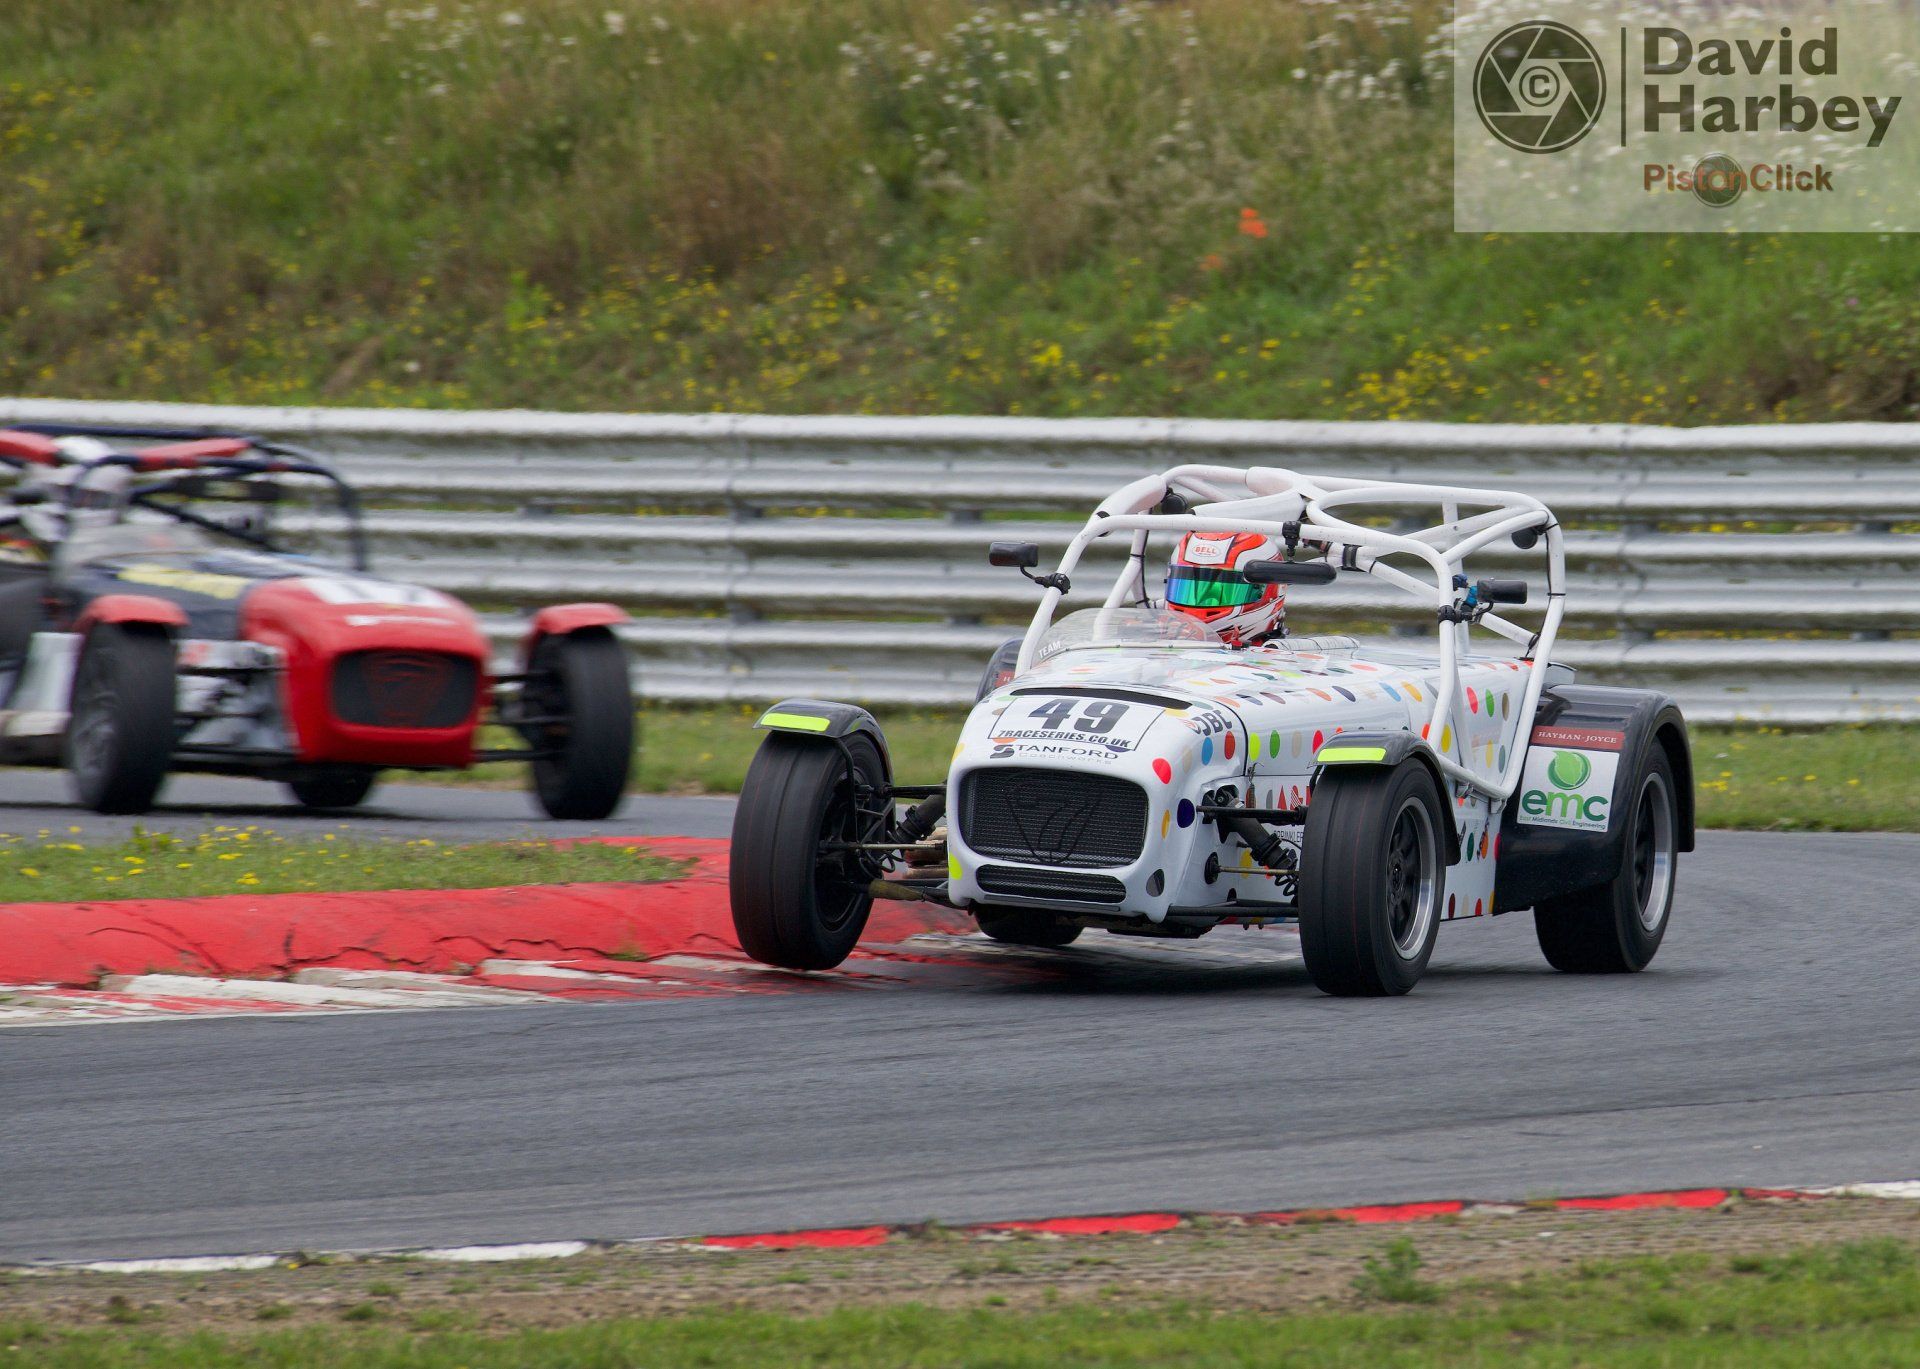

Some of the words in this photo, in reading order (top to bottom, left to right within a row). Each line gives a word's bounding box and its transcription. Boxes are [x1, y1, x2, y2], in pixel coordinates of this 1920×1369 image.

[1195, 546, 1216, 554] BELL
[1039, 640, 1061, 658] TEAM
[1028, 698, 1130, 734] 49
[997, 729, 1133, 749] 7RACESERIES.CO.UK
[990, 744, 1119, 760] STANFORD
[1521, 789, 1609, 822] emc
